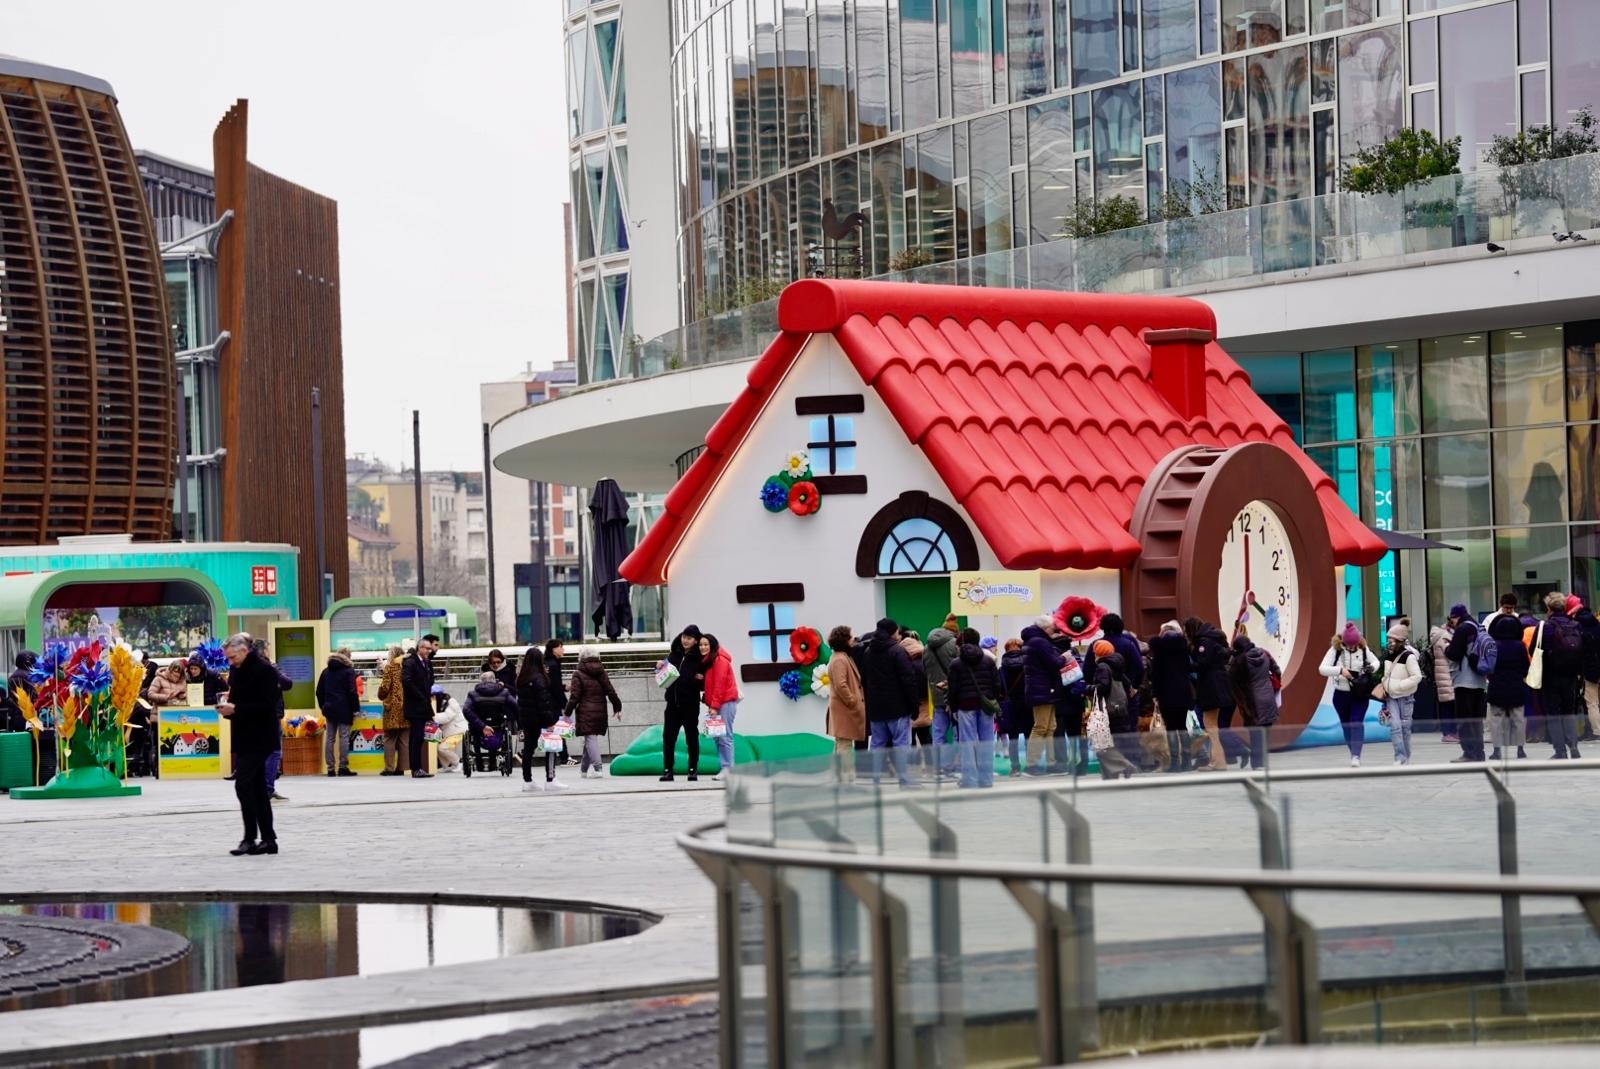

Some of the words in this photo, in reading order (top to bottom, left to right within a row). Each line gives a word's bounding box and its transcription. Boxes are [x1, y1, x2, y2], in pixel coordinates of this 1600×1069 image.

[1238, 513, 1251, 533] 12
[1259, 525, 1265, 544] 1
[1271, 550, 1279, 571] 2
[1278, 586, 1286, 606] 3
